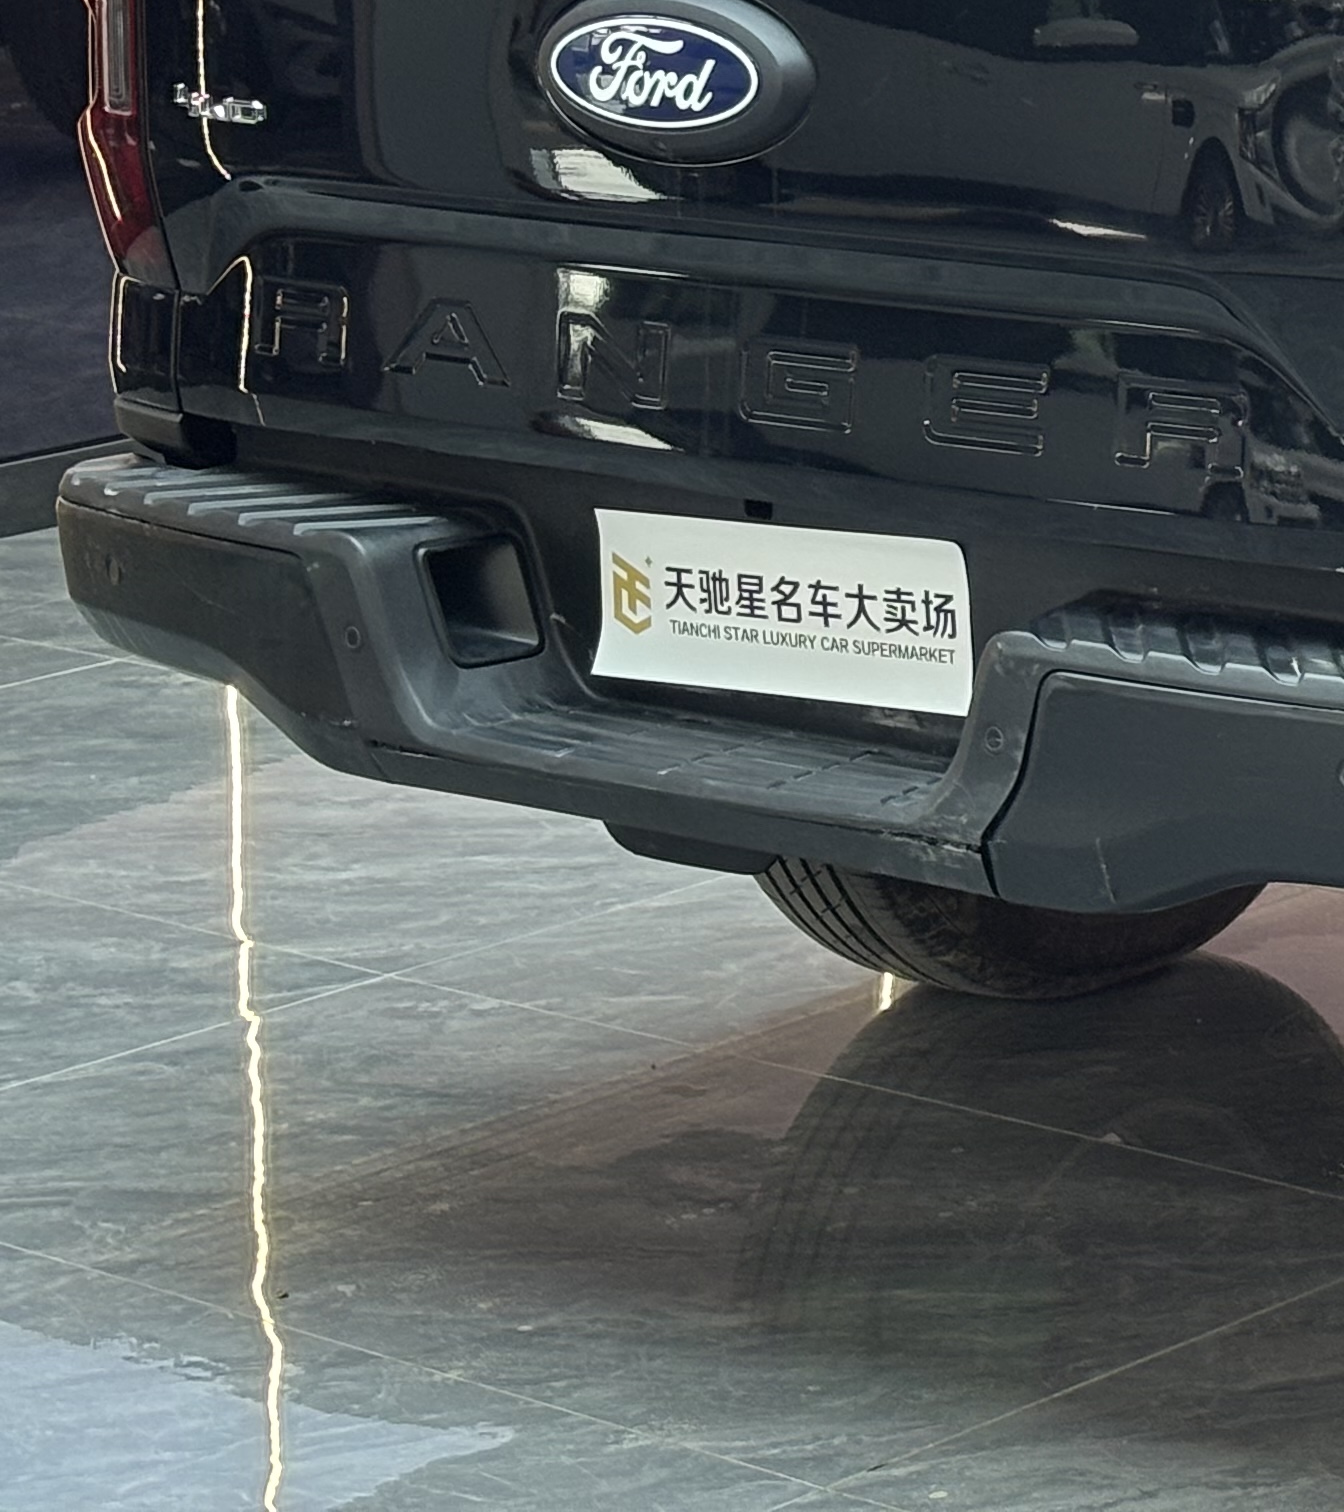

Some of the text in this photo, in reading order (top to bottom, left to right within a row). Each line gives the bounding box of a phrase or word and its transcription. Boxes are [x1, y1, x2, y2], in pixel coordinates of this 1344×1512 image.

[589, 31, 717, 112] Ford
[252, 276, 1249, 482] RANGER
[663, 566, 957, 640] 天驰星名车大卖场
[670, 619, 956, 665] TIANCHI STAR LUXURY CAR SUPERMARKET
